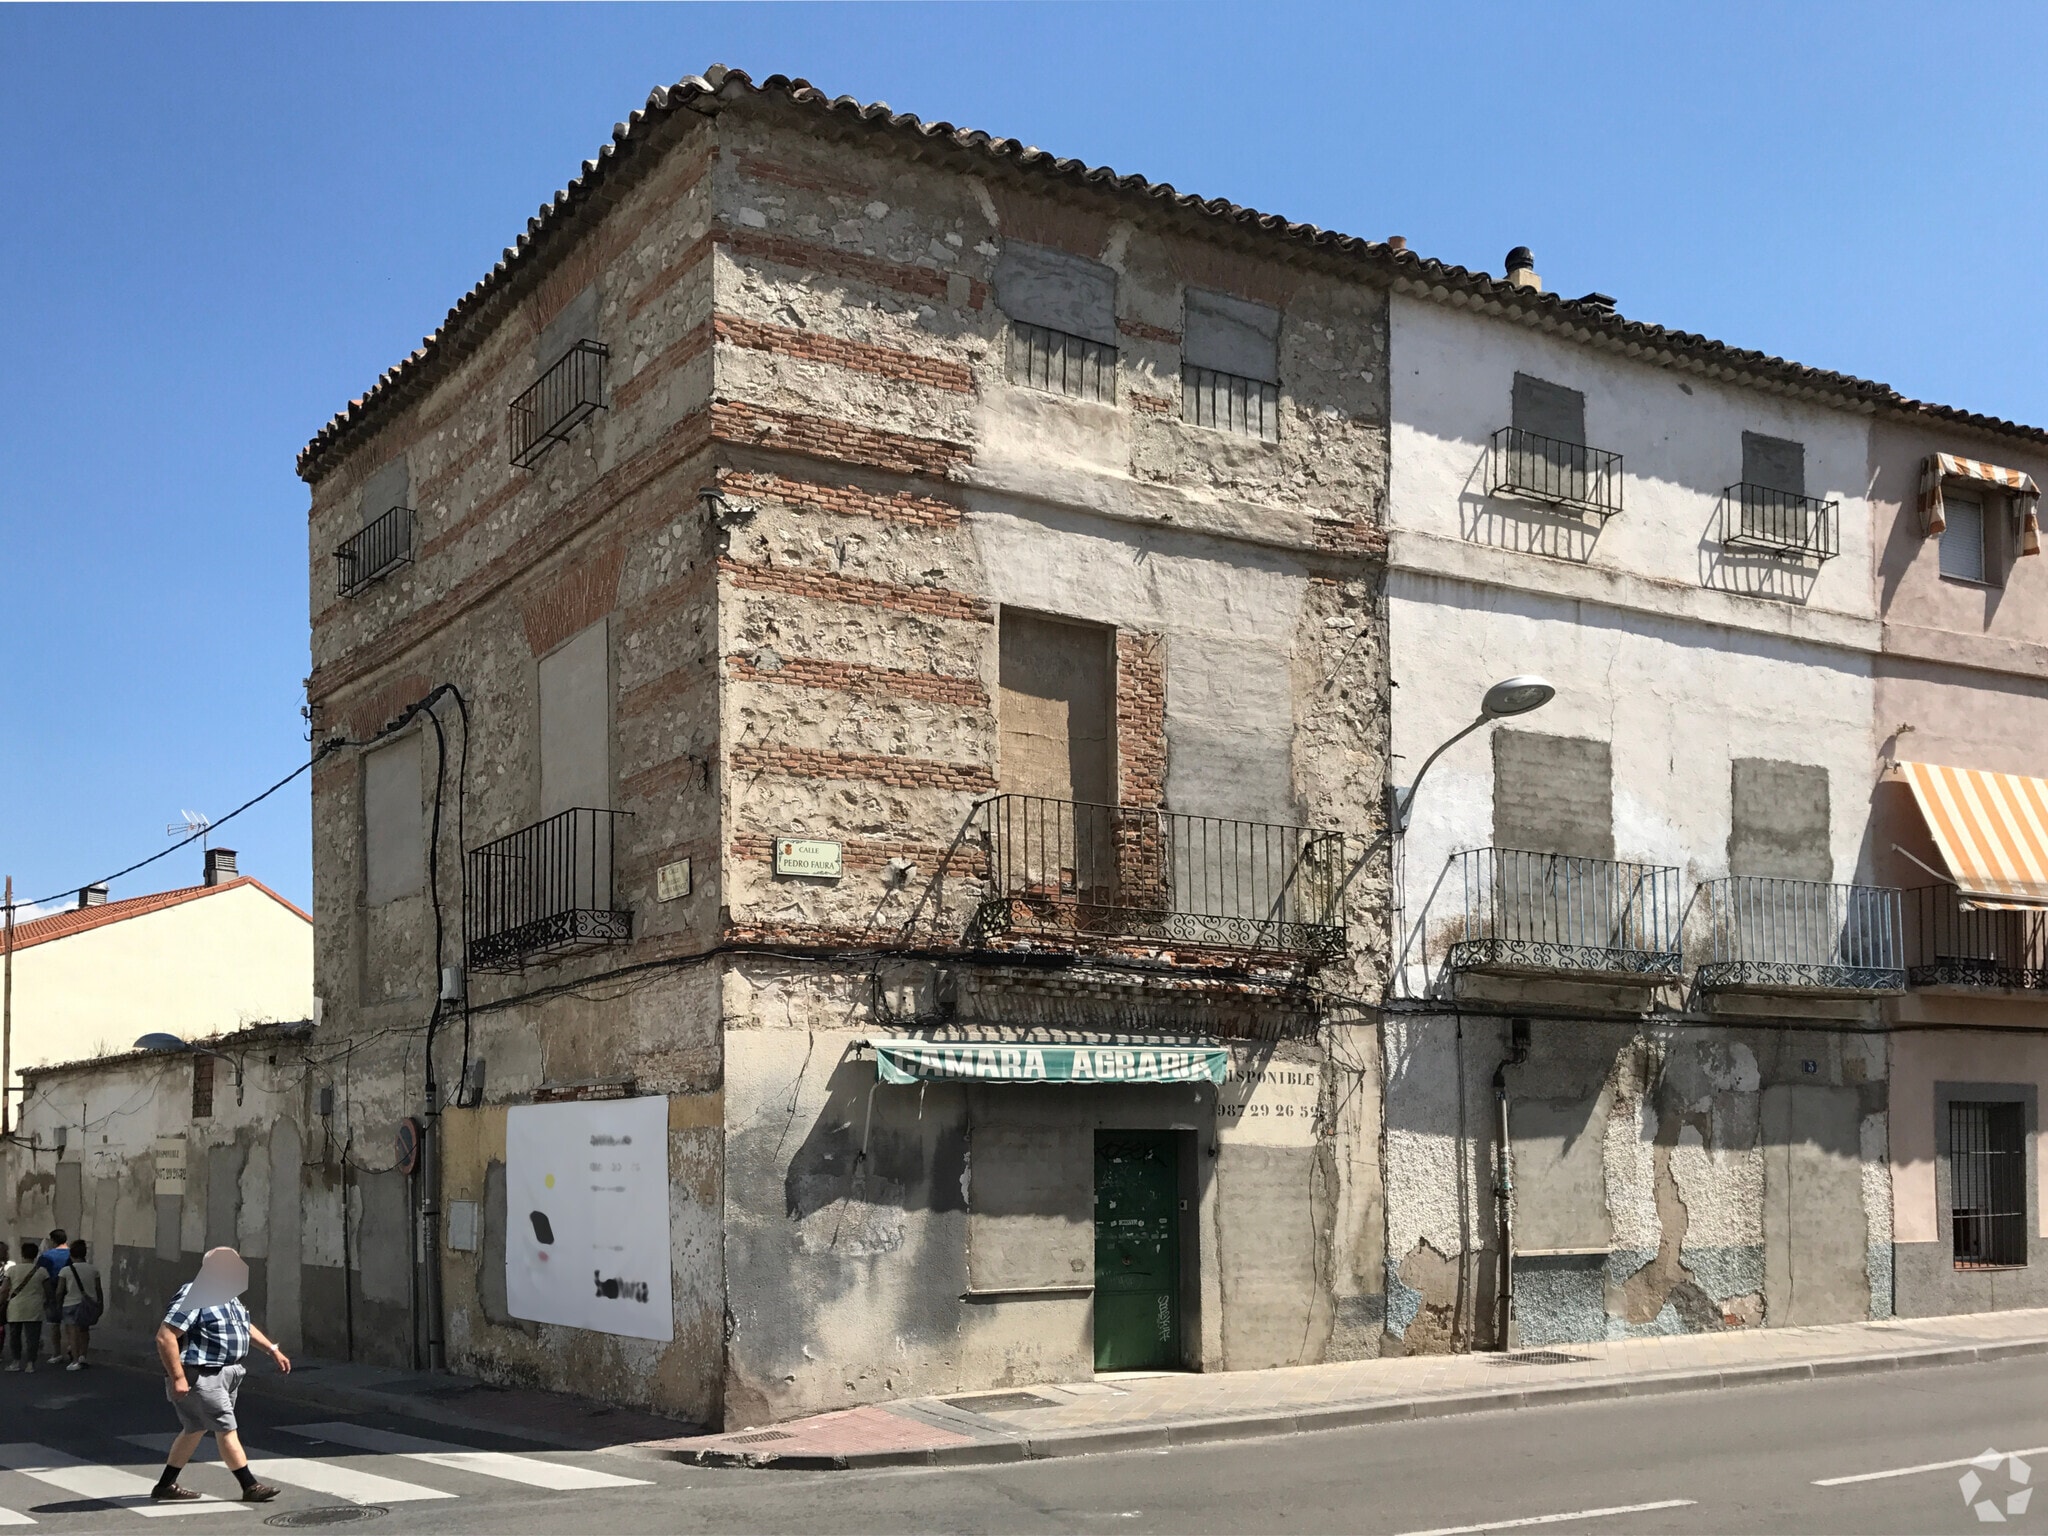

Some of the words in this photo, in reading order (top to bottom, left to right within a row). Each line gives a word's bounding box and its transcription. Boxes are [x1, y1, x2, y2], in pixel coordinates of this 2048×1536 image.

[798, 846, 819, 854] CALLE
[783, 859, 809, 868] PEDRO
[810, 860, 835, 870] FAURA
[1071, 1050, 1213, 1079] AGRARIA
[1228, 1069, 1315, 1086] ISPONIBLE
[1217, 1104, 1245, 1117] 987
[1250, 1104, 1270, 1117] 29
[1275, 1104, 1294, 1117] 26
